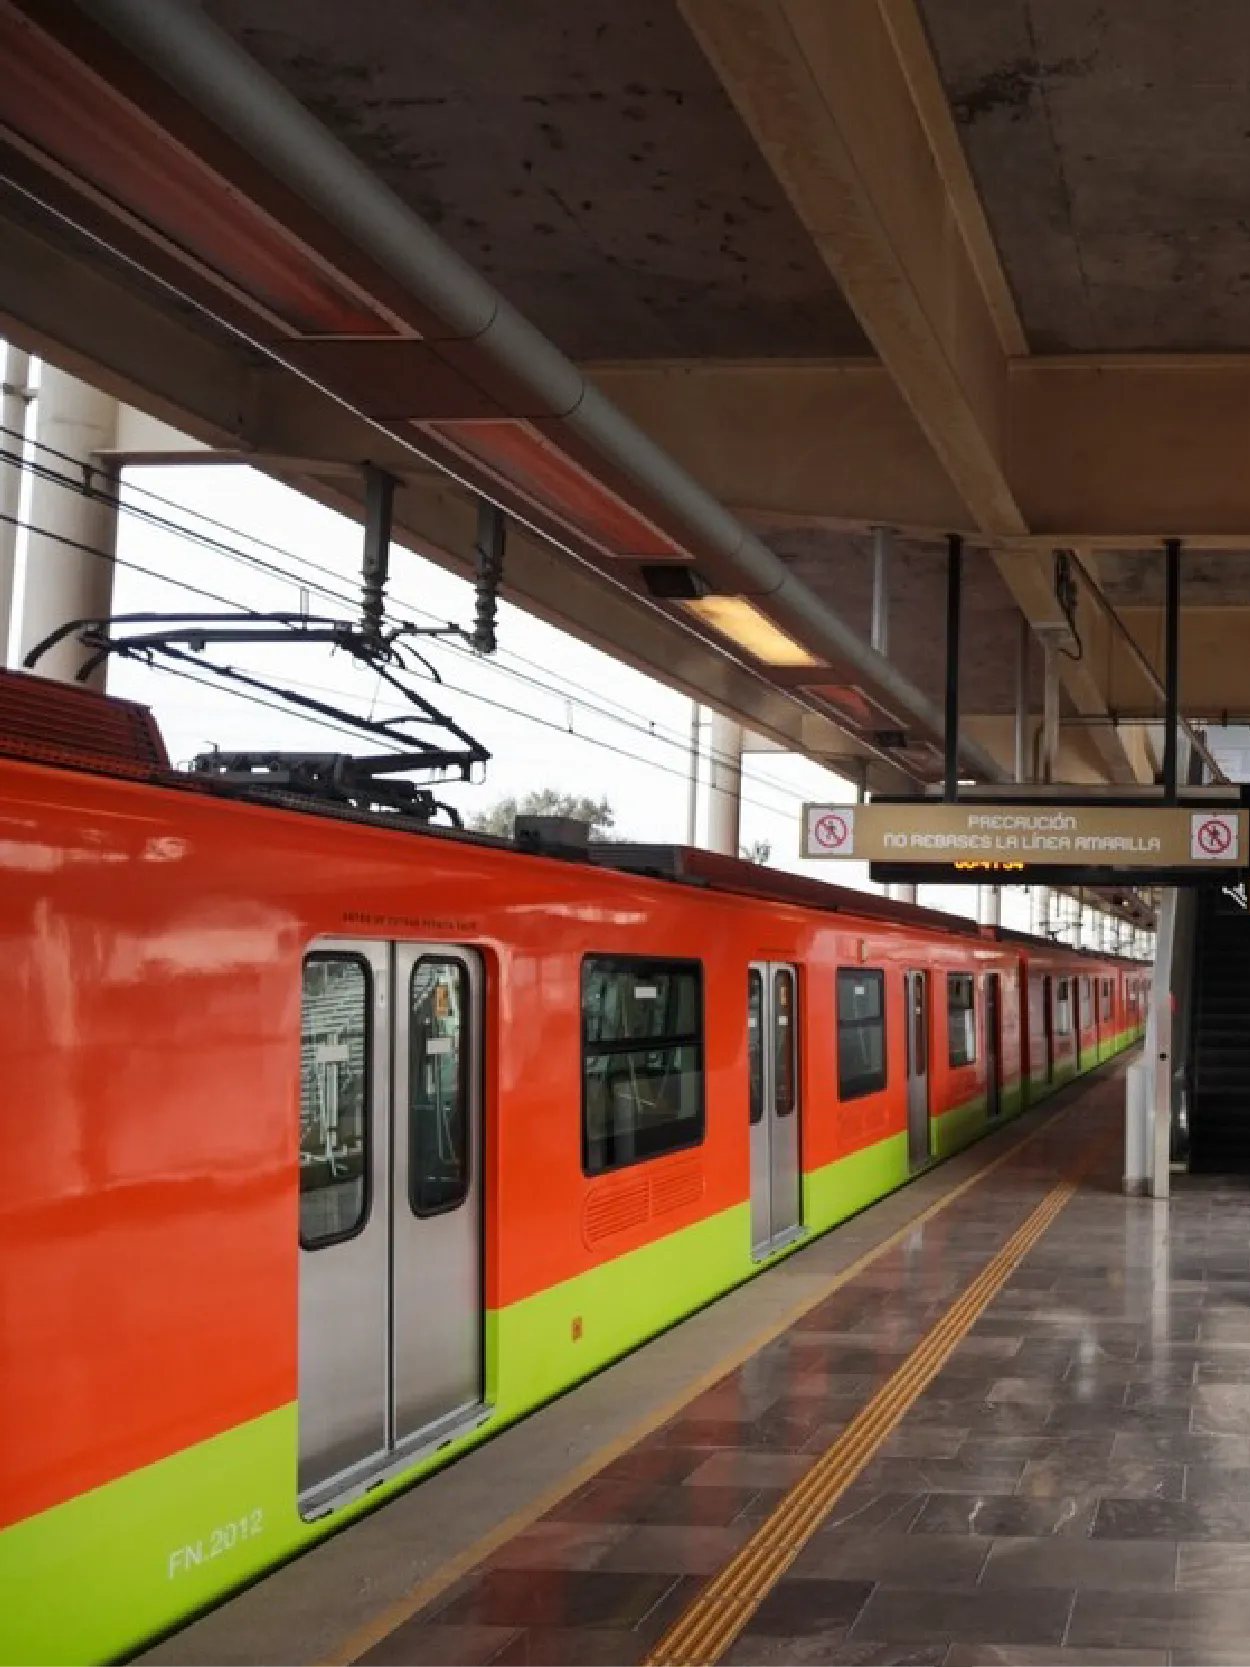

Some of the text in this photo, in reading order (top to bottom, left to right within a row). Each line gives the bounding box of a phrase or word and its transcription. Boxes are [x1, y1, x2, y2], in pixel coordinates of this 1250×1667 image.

[967, 811, 1078, 831] PRECAUCIÓN
[883, 831, 1161, 852] NO REBASES LA LÍNEA AMARILLA
